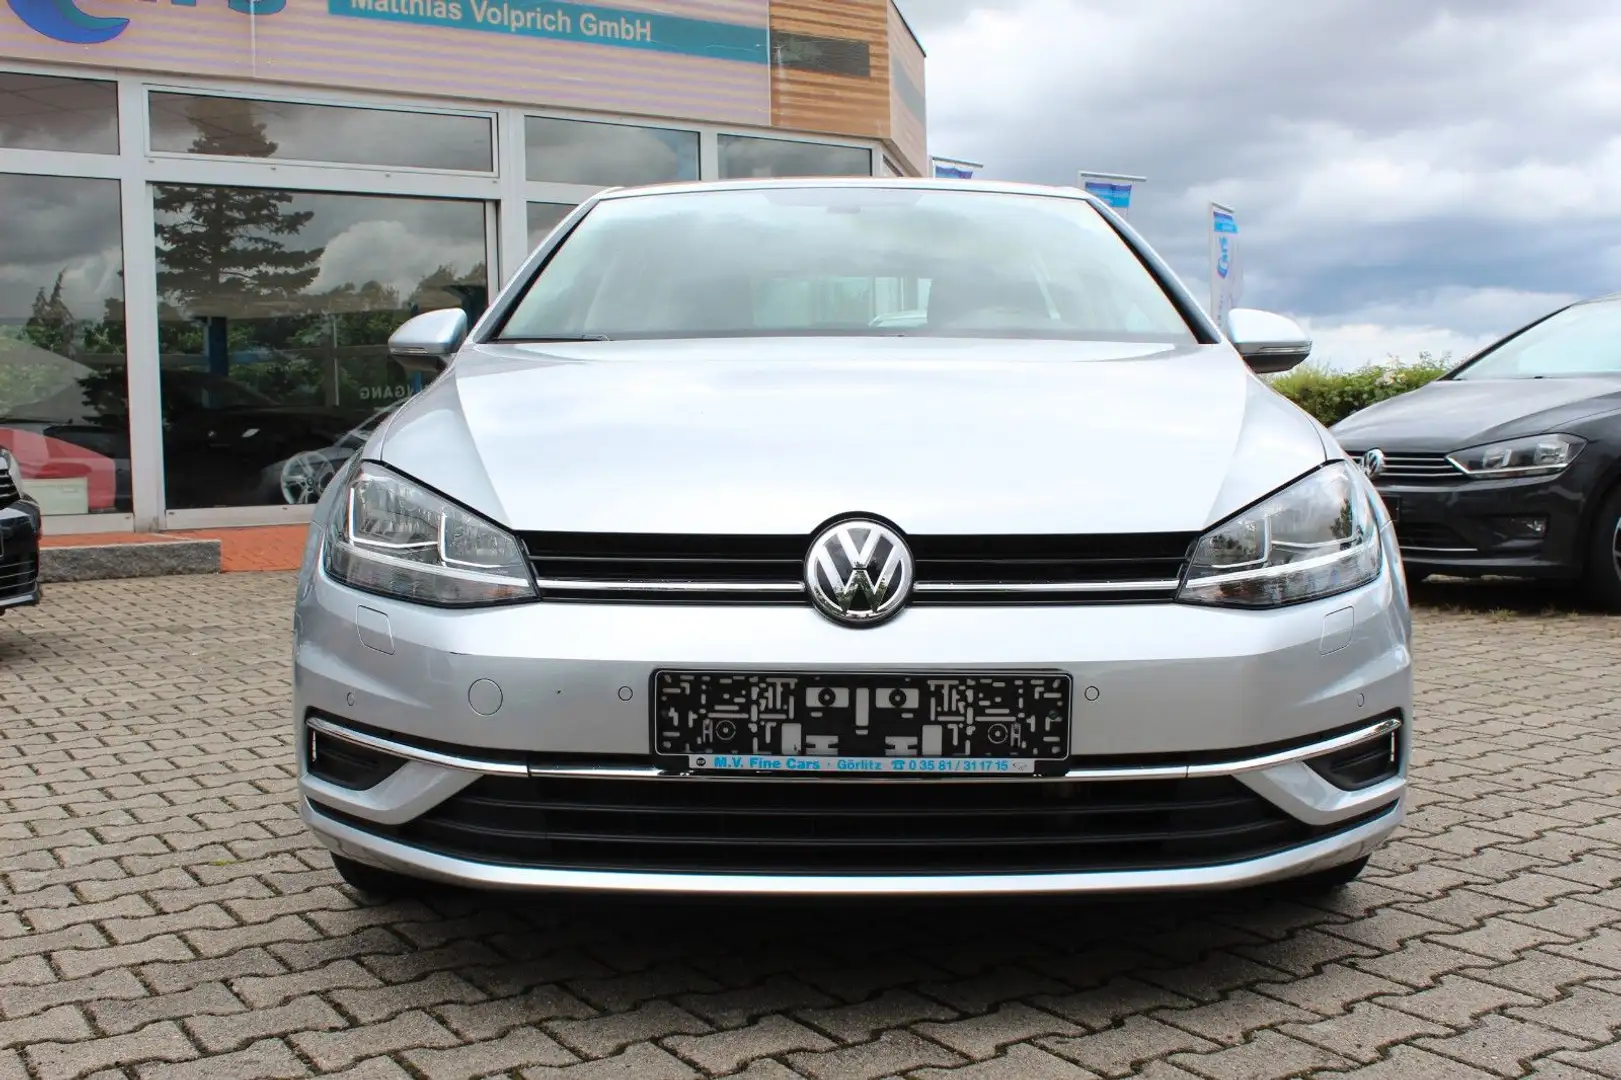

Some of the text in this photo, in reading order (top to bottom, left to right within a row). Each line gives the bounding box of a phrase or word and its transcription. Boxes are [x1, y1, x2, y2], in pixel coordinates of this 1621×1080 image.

[469, 0, 571, 33] Volprich
[579, 13, 651, 42] GmbH
[714, 757, 743, 768] M.V.
[750, 757, 781, 769] Fine
[786, 758, 820, 770] Cars
[837, 759, 881, 770] Görlitz
[909, 760, 916, 771] 0
